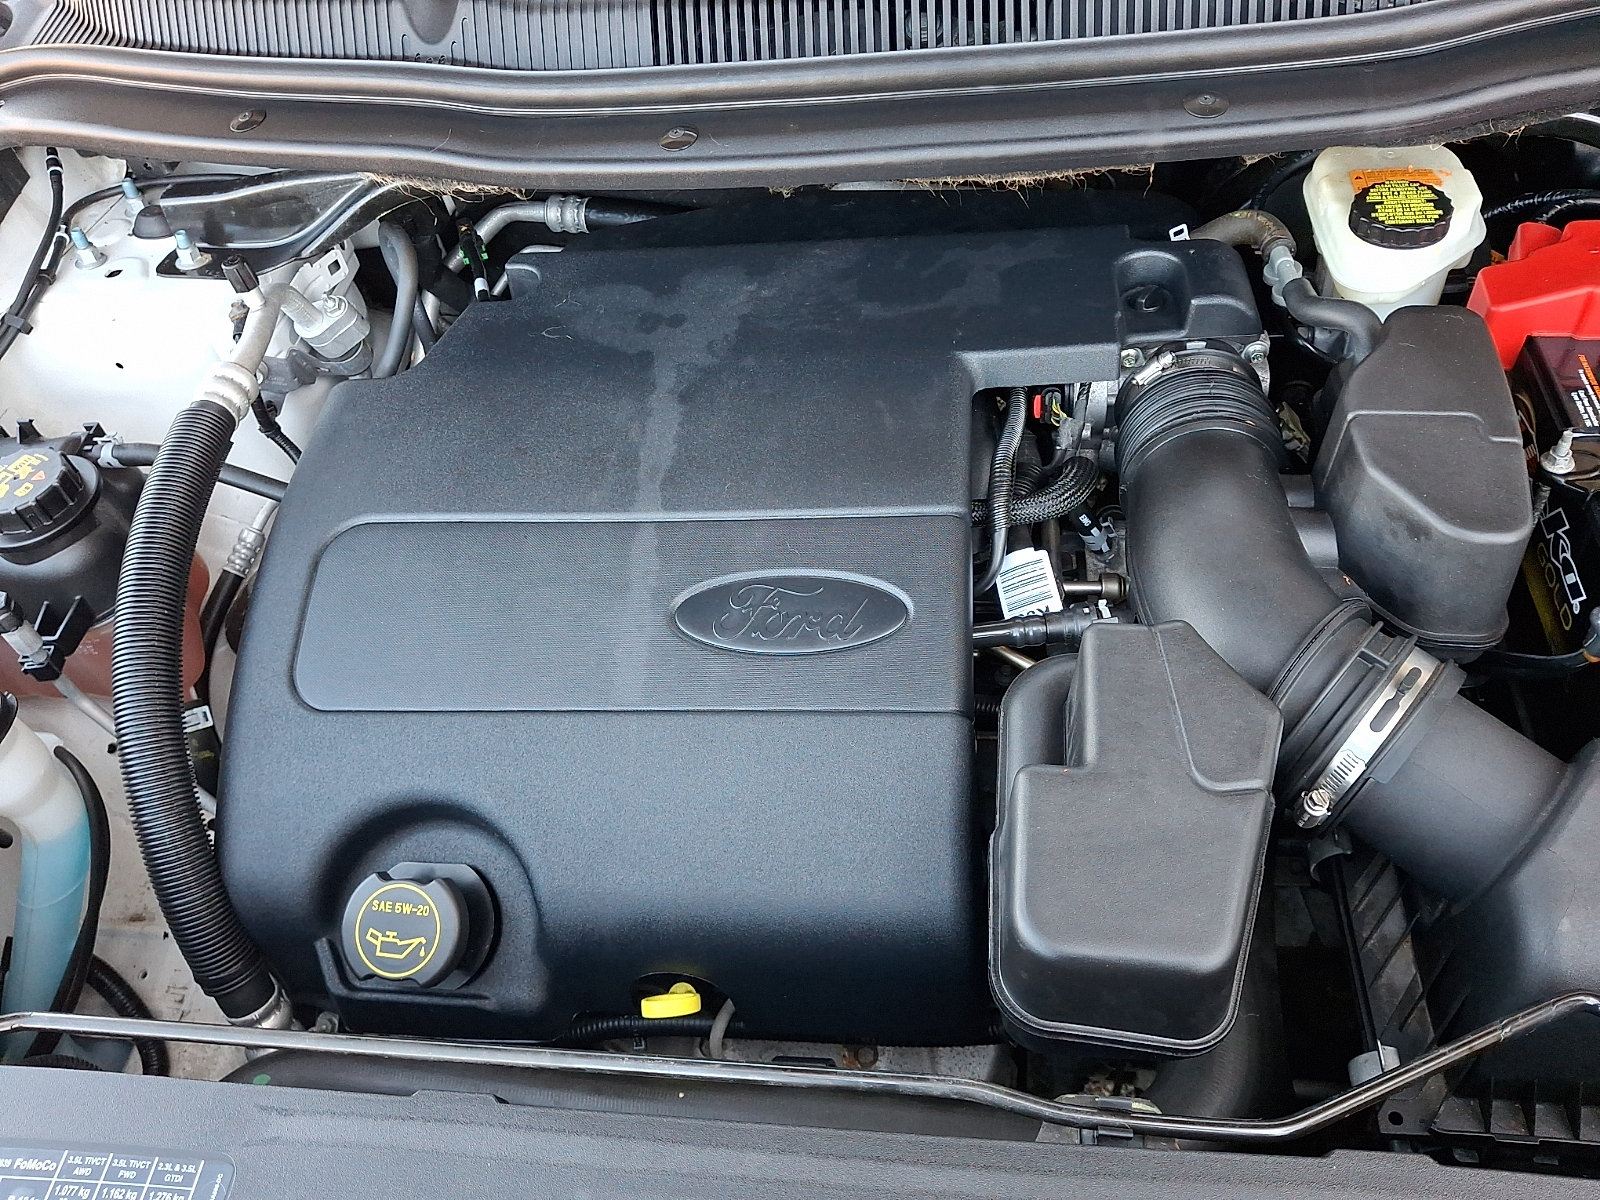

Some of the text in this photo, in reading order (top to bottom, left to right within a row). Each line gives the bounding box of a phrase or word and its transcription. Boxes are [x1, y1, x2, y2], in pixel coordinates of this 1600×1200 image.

[1537, 542, 1572, 631] GOLD
[712, 584, 868, 641] Ford
[371, 900, 430, 916] SAE 5W-20
[13, 1157, 57, 1171] FoMoCo
[174, 1164, 181, 1172] &
[72, 1167, 92, 1176] AWD
[117, 1169, 137, 1179] FWD
[78, 1185, 91, 1199] kg
[101, 1187, 138, 1200] 1.162 kg
